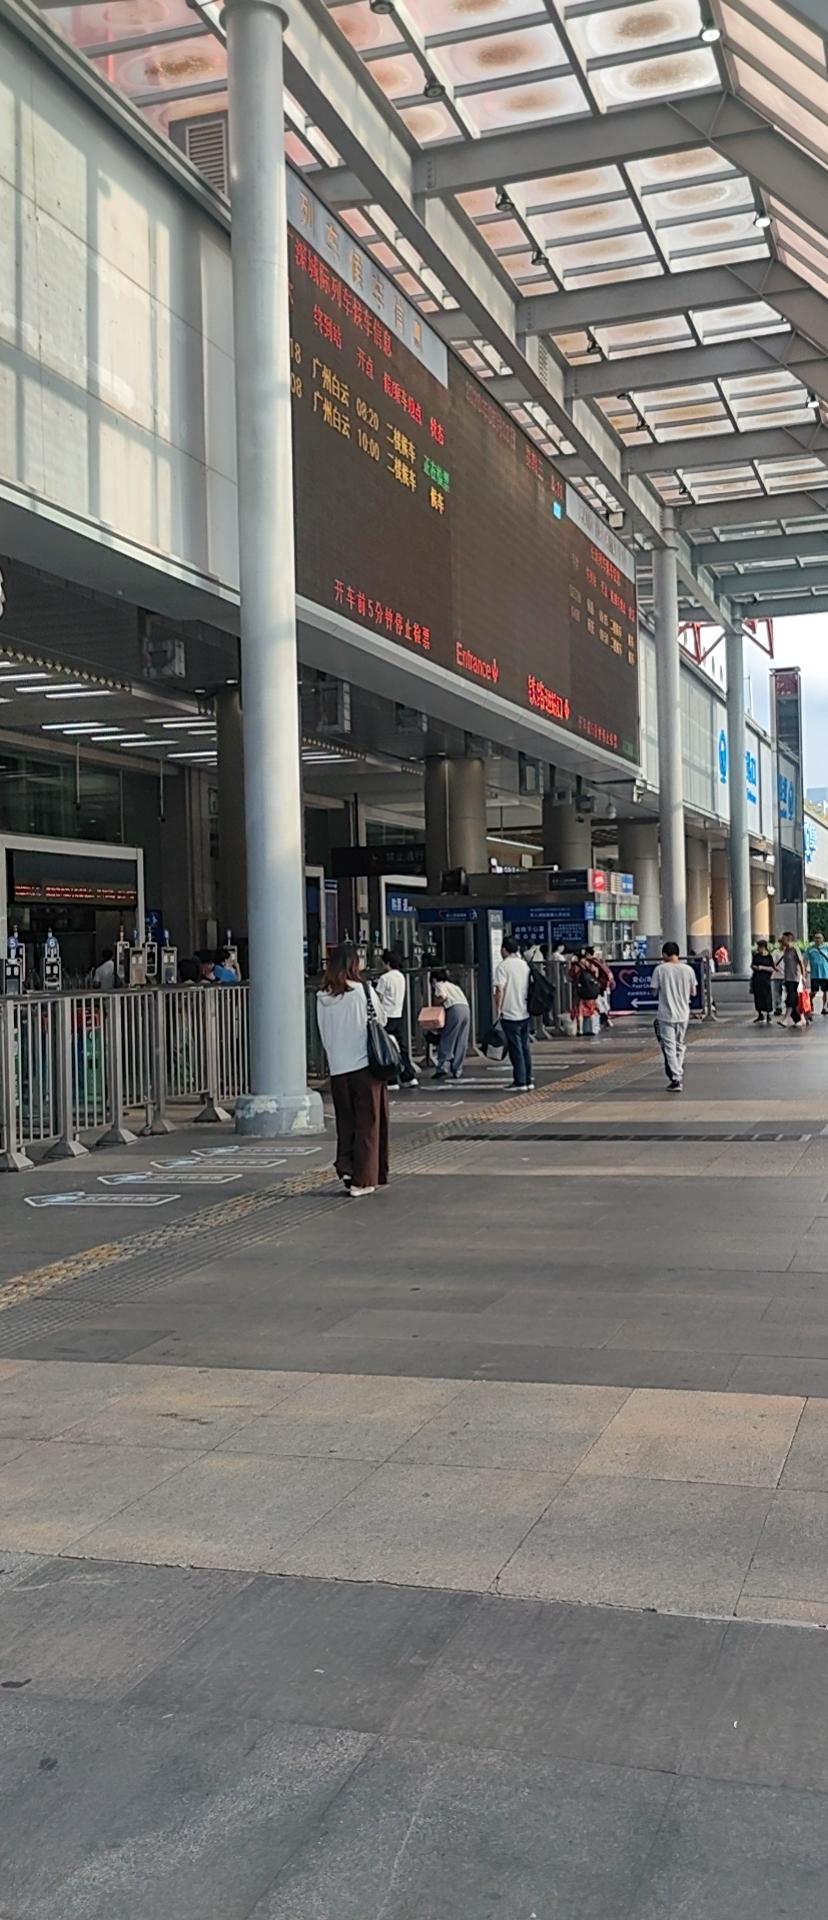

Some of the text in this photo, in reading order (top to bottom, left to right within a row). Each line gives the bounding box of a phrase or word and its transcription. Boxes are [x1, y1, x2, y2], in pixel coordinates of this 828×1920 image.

[312, 358, 349, 407] 广州白云
[355, 397, 380, 431] 08:20
[313, 391, 350, 439] 广州白云
[357, 428, 380, 461] 10:00
[334, 579, 431, 650] 开车前5分钟停止检票
[456, 641, 491, 680] Entrance
